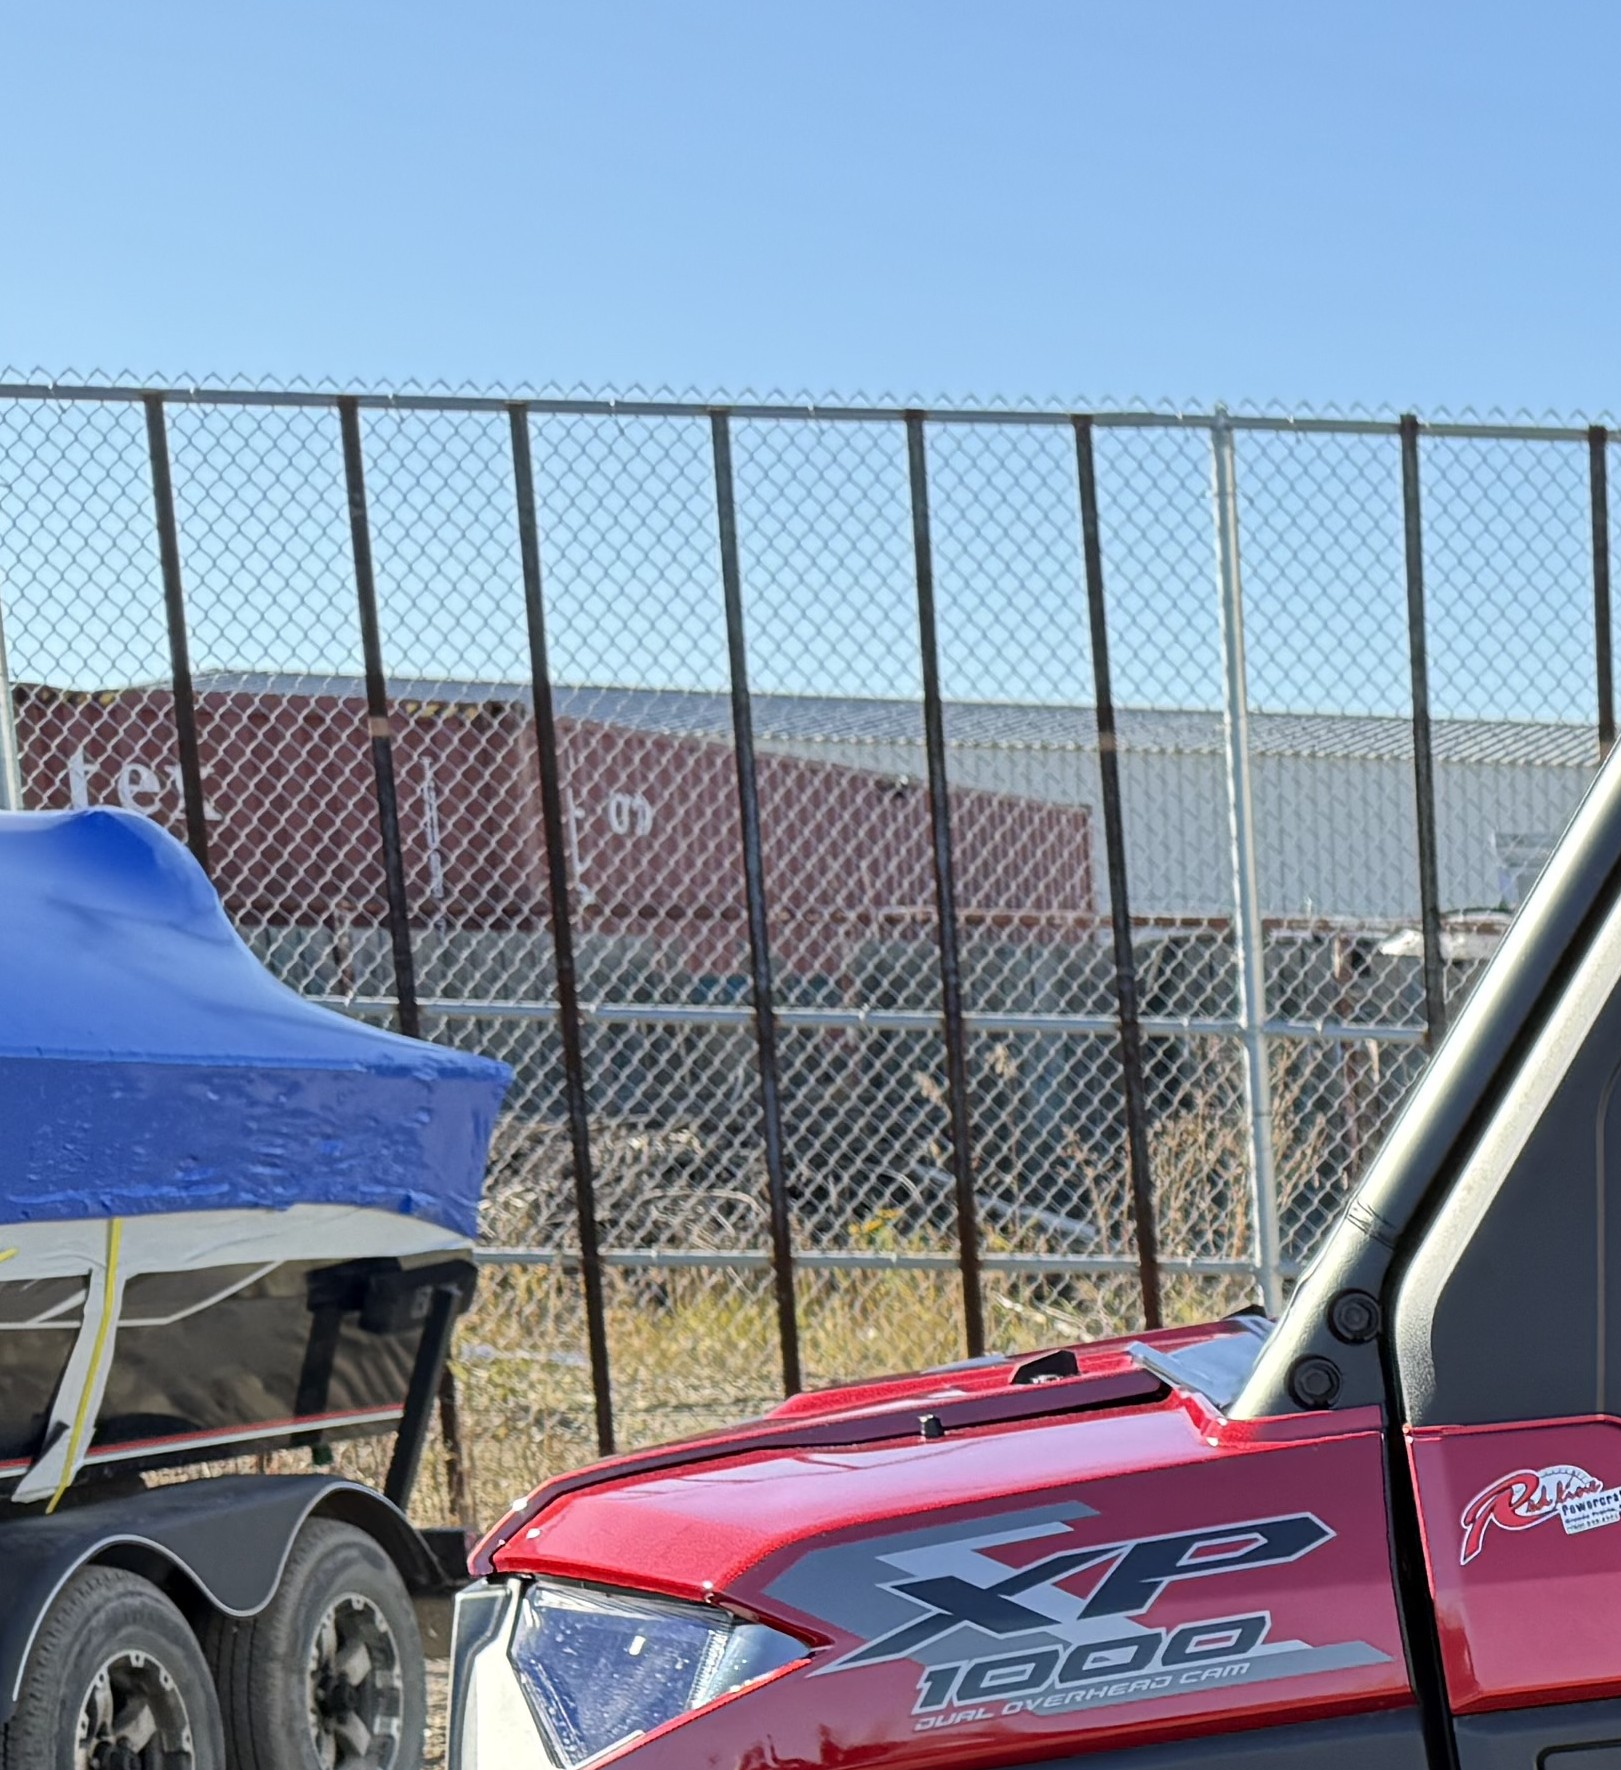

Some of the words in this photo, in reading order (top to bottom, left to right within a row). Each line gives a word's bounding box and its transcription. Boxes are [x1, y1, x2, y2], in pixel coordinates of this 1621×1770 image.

[808, 1512, 1336, 1676] XP
[912, 1610, 1272, 1716] 1000
[913, 1707, 995, 1733] DUAL
[1002, 1674, 1170, 1716] OVERHEAD
[1179, 1662, 1250, 1685] CAM
